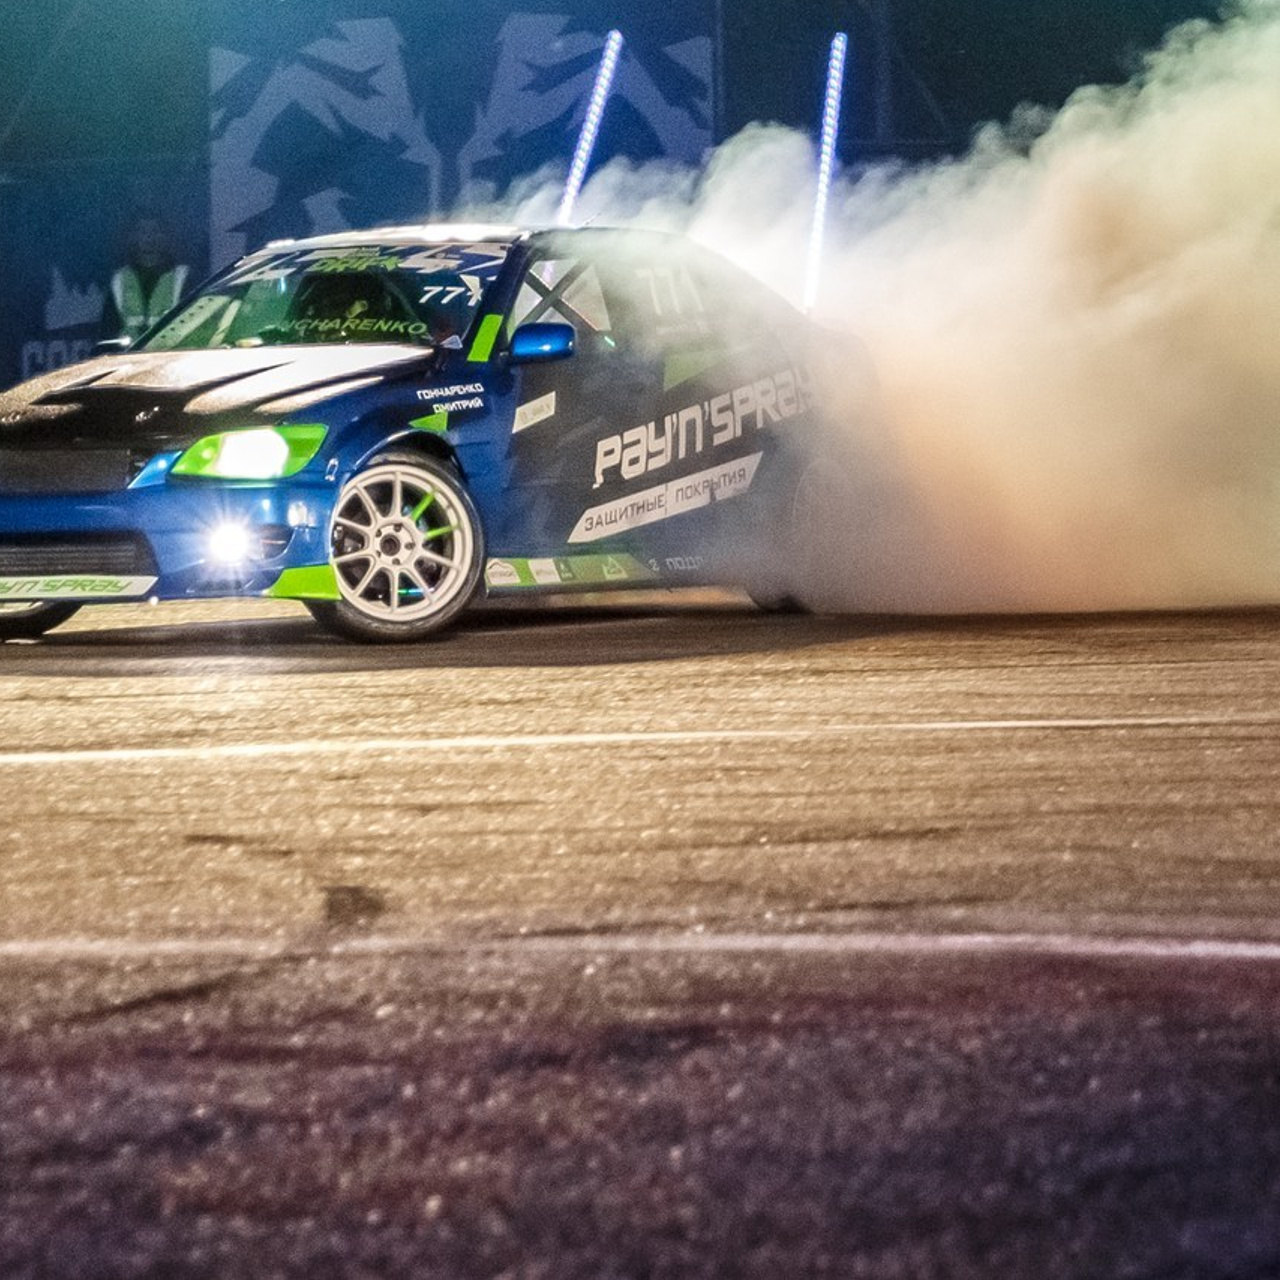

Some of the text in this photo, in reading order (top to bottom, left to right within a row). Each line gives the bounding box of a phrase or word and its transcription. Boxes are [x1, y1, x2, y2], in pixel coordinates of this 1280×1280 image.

[416, 382, 484, 400] ГОНЧАРЕНКО
[432, 396, 484, 414] ДМИТРИЙ
[584, 466, 747, 532] ЗАЩИТНЫЕ ПОКРЫТИЯ
